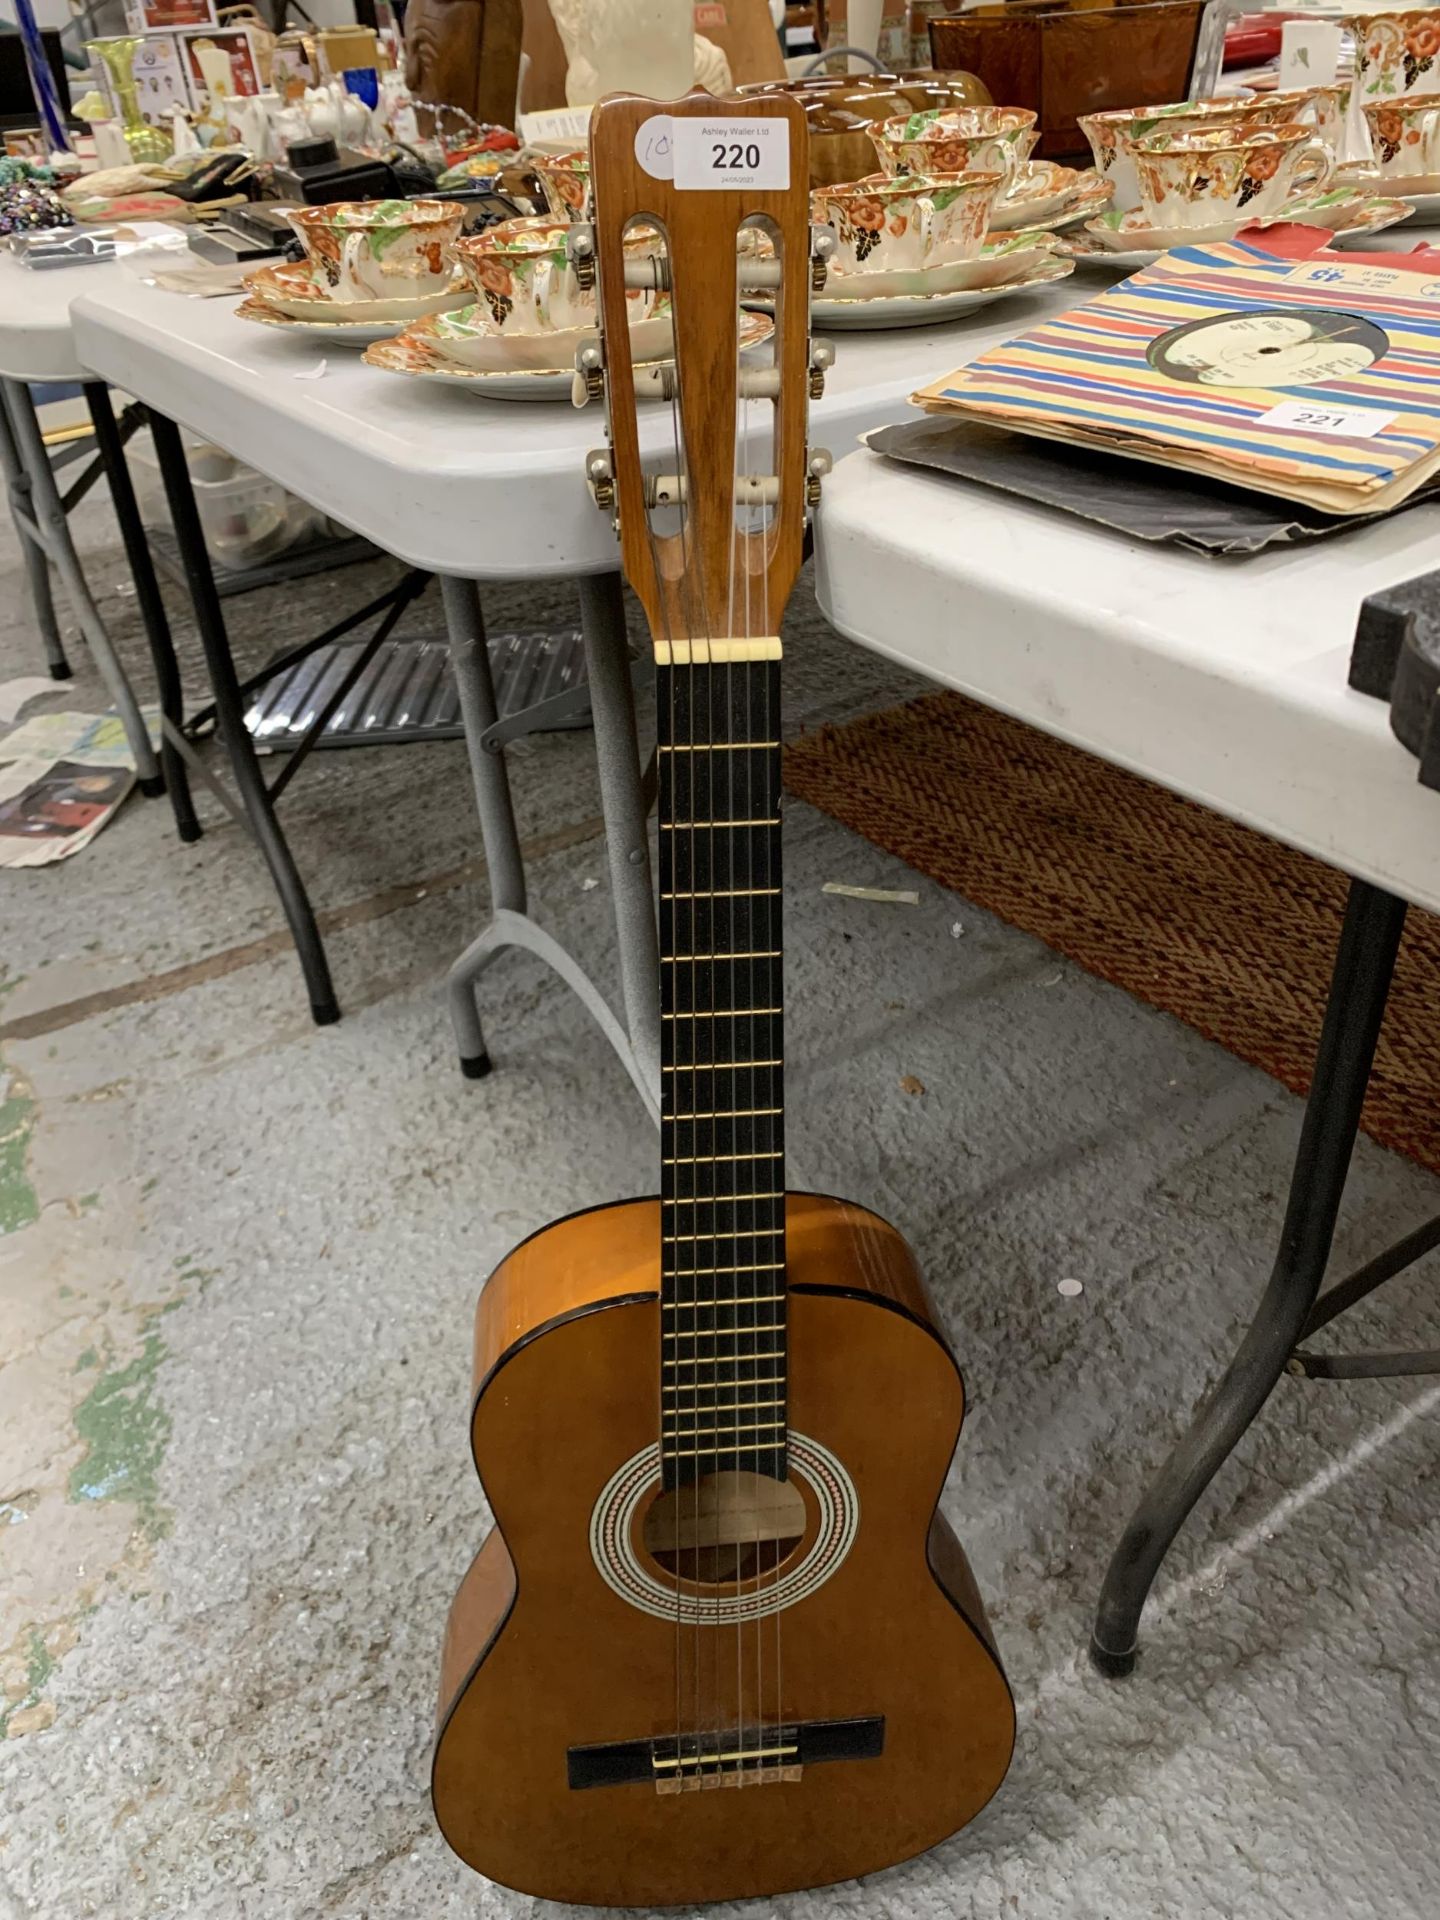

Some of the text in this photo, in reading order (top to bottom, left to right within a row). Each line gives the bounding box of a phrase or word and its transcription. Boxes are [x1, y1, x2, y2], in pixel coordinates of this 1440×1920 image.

[702, 127, 769, 137] Ashley Waller Ltd
[712, 144, 760, 169] 220
[1306, 269, 1344, 283] 45
[1292, 413, 1345, 427] 221
